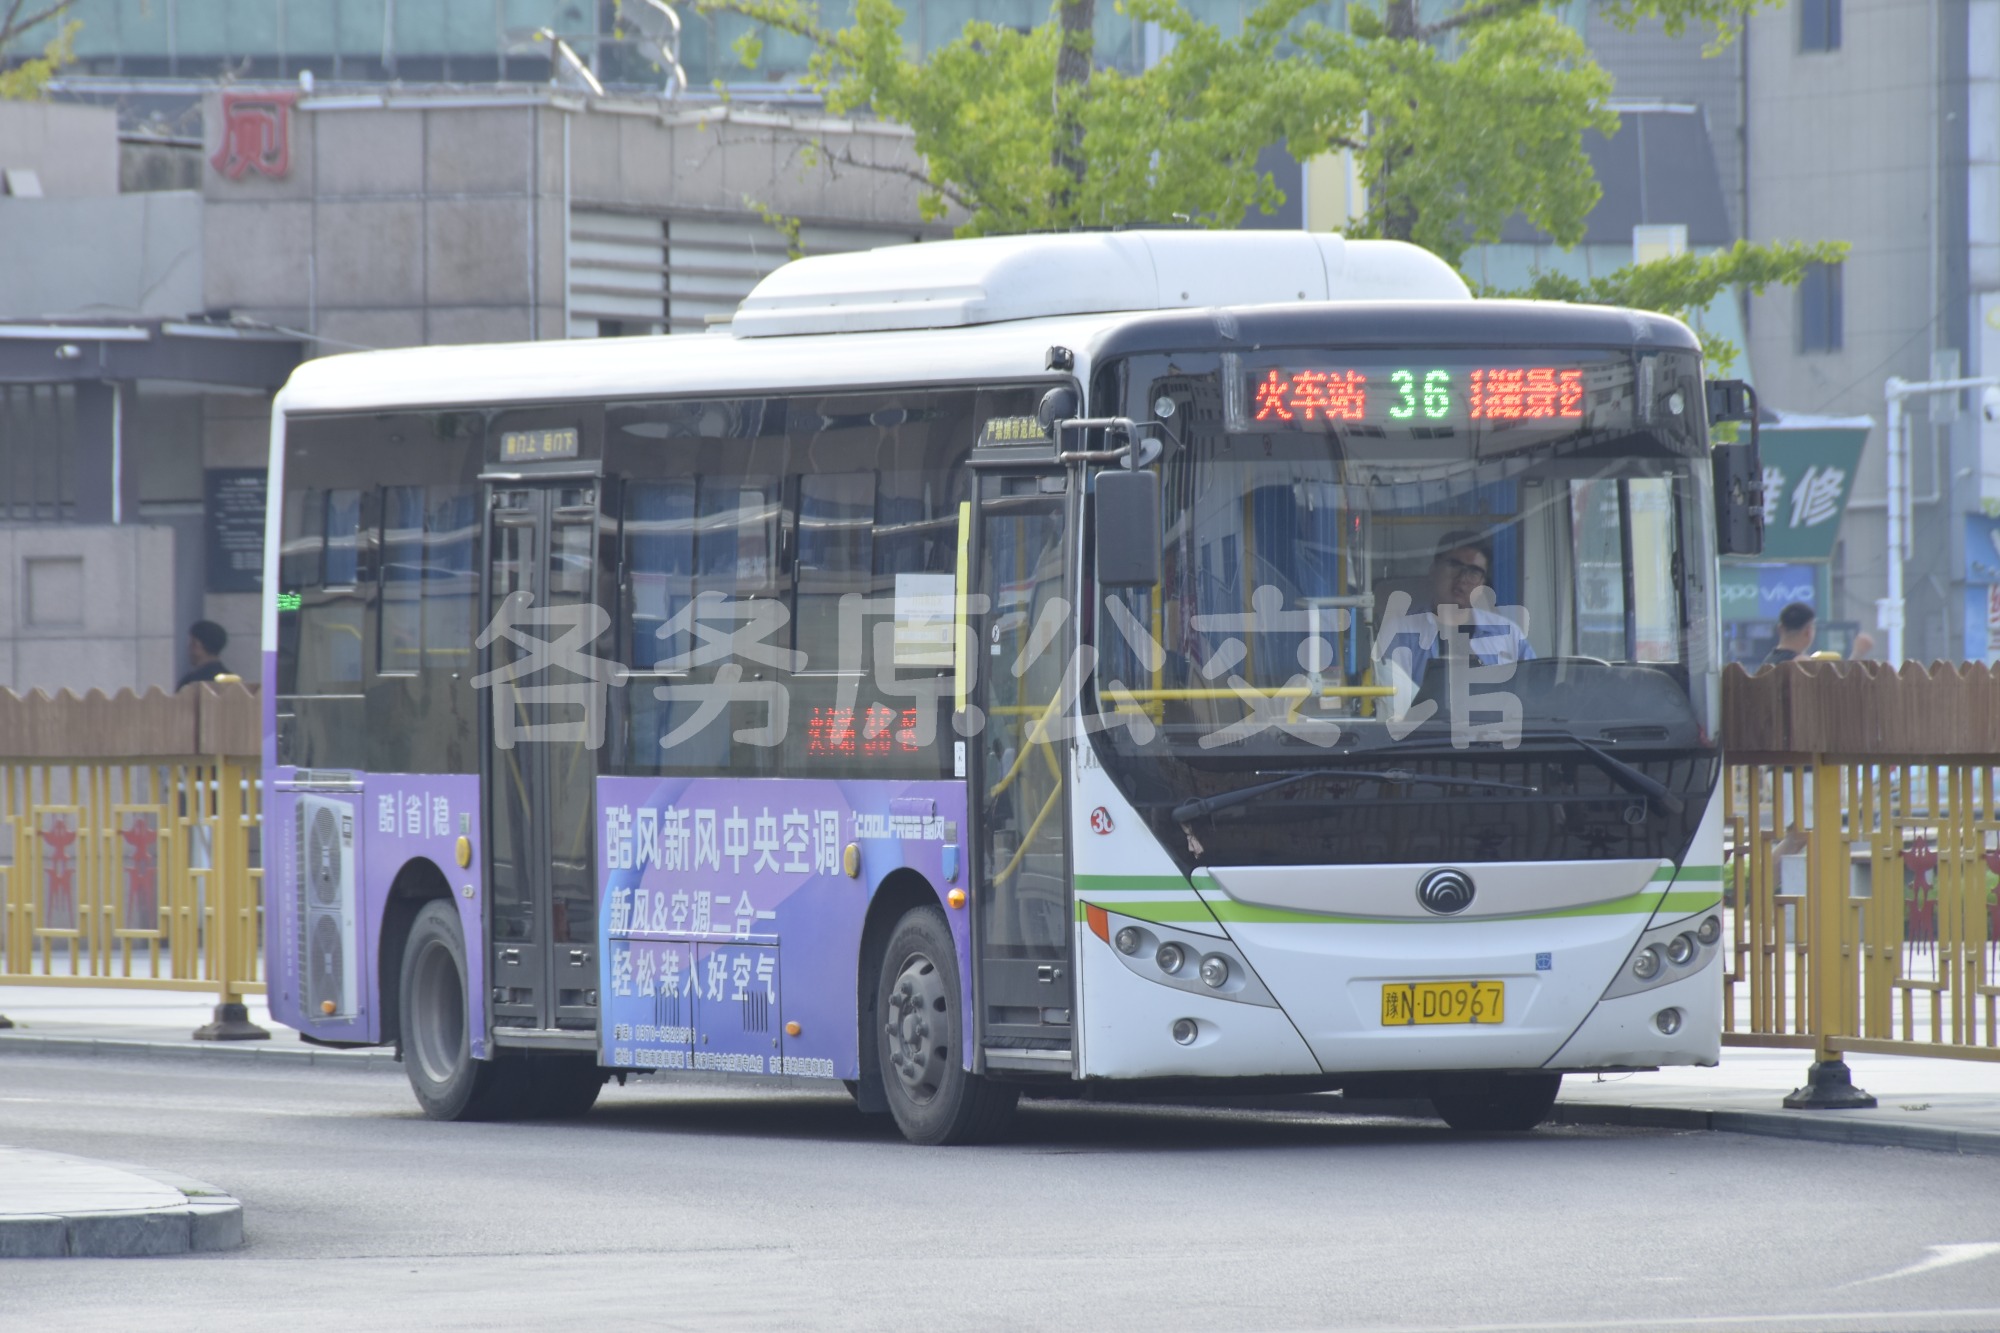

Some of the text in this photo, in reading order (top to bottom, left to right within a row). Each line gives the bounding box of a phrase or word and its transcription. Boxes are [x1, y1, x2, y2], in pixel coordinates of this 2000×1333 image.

[210, 92, 296, 180] 厕
[1255, 370, 1366, 420] 火车站
[1390, 370, 1450, 419] 36
[1760, 582, 1815, 601] vivo
[605, 805, 840, 876] 酷风新风中央空调
[609, 886, 777, 941] 新风&空调二合一
[611, 948, 776, 1005] 轻松装入好空气
